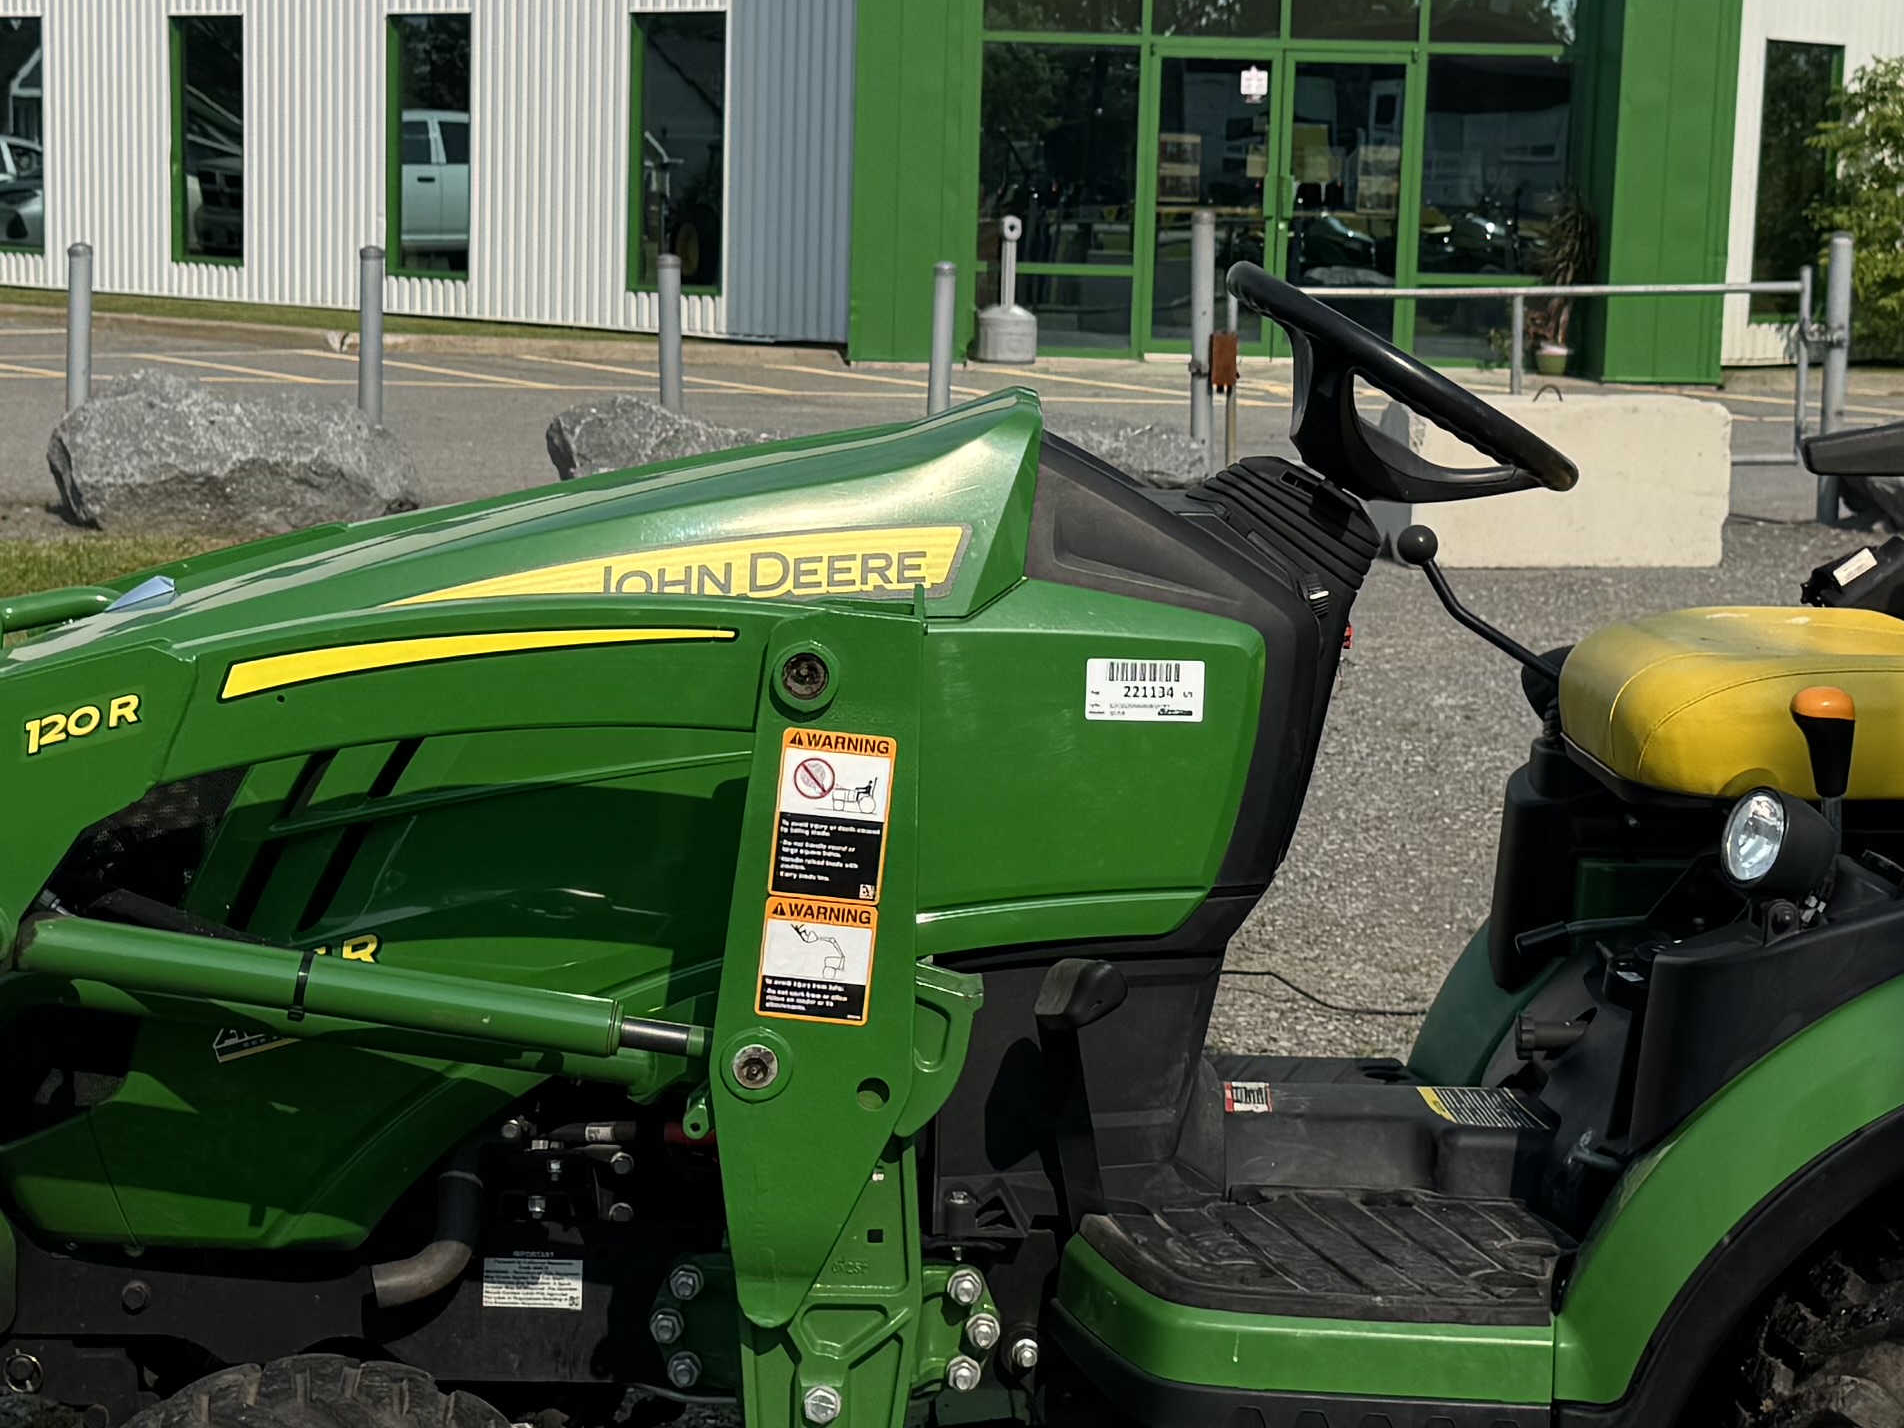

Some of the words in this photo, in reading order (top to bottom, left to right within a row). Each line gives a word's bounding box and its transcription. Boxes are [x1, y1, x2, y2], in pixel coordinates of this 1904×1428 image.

[602, 562, 733, 595] JOHN
[749, 551, 927, 593] DEERE
[1124, 686, 1174, 699] 221134
[26, 705, 101, 754] 120
[108, 694, 139, 728] R
[806, 733, 890, 755] WARNING
[788, 902, 872, 925] WARNING
